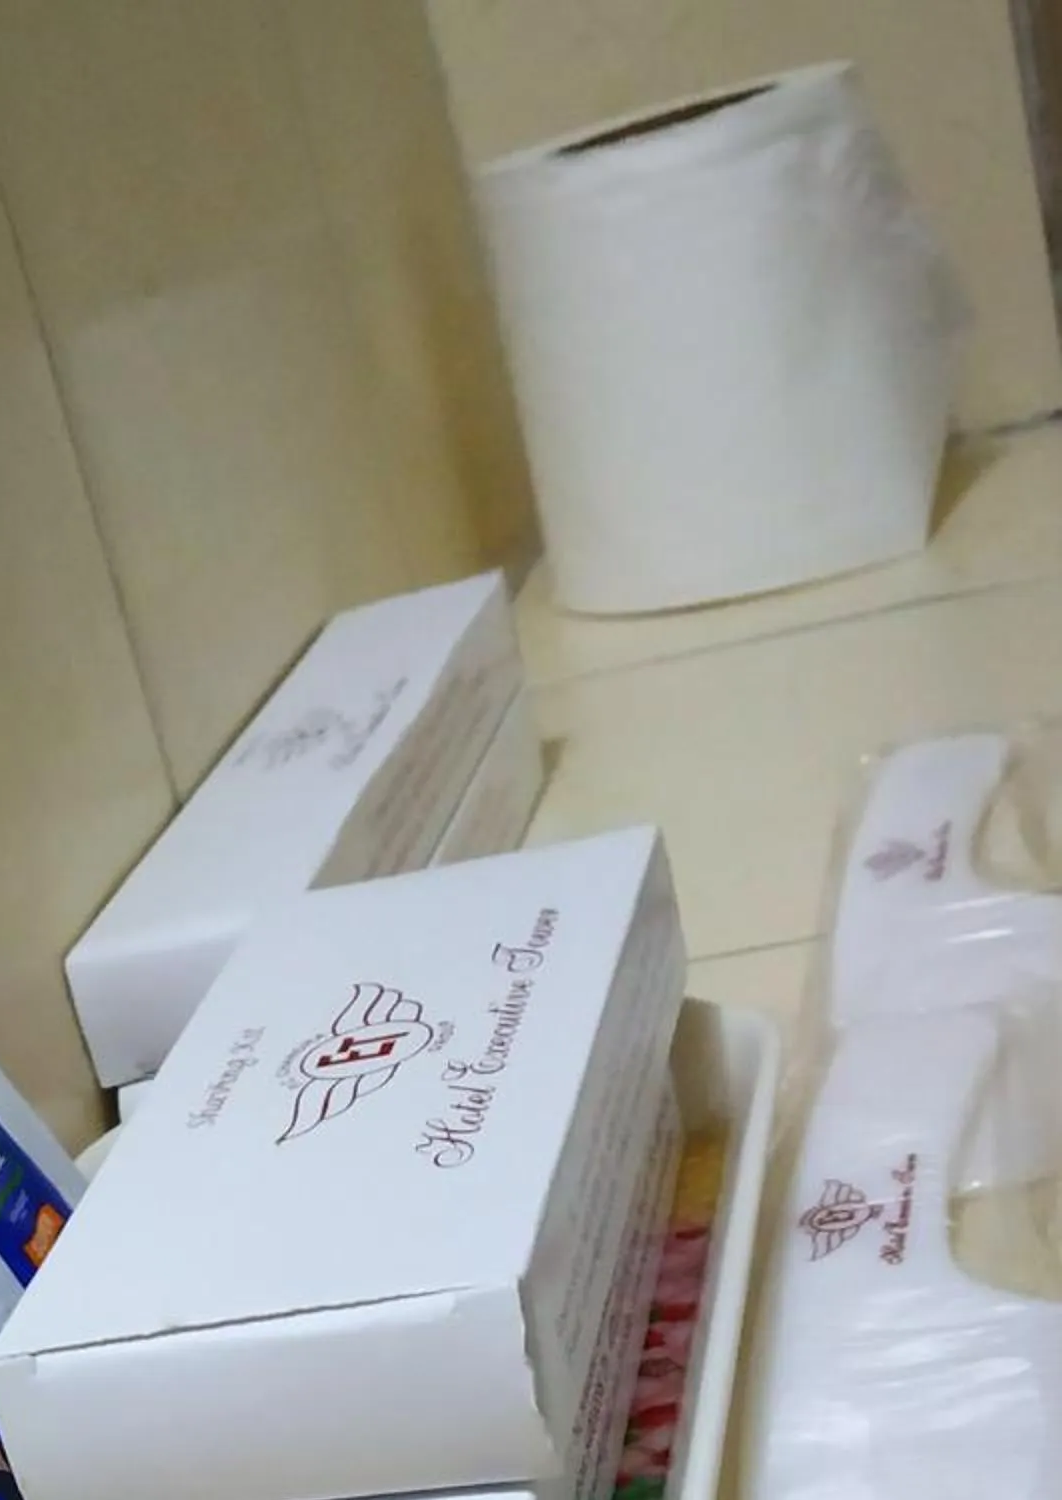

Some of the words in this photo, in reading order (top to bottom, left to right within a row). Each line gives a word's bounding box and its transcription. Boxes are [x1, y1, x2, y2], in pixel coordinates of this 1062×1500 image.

[317, 1031, 410, 1068] ET
[441, 978, 536, 1081] Executive
[415, 1085, 496, 1168] Hotel
